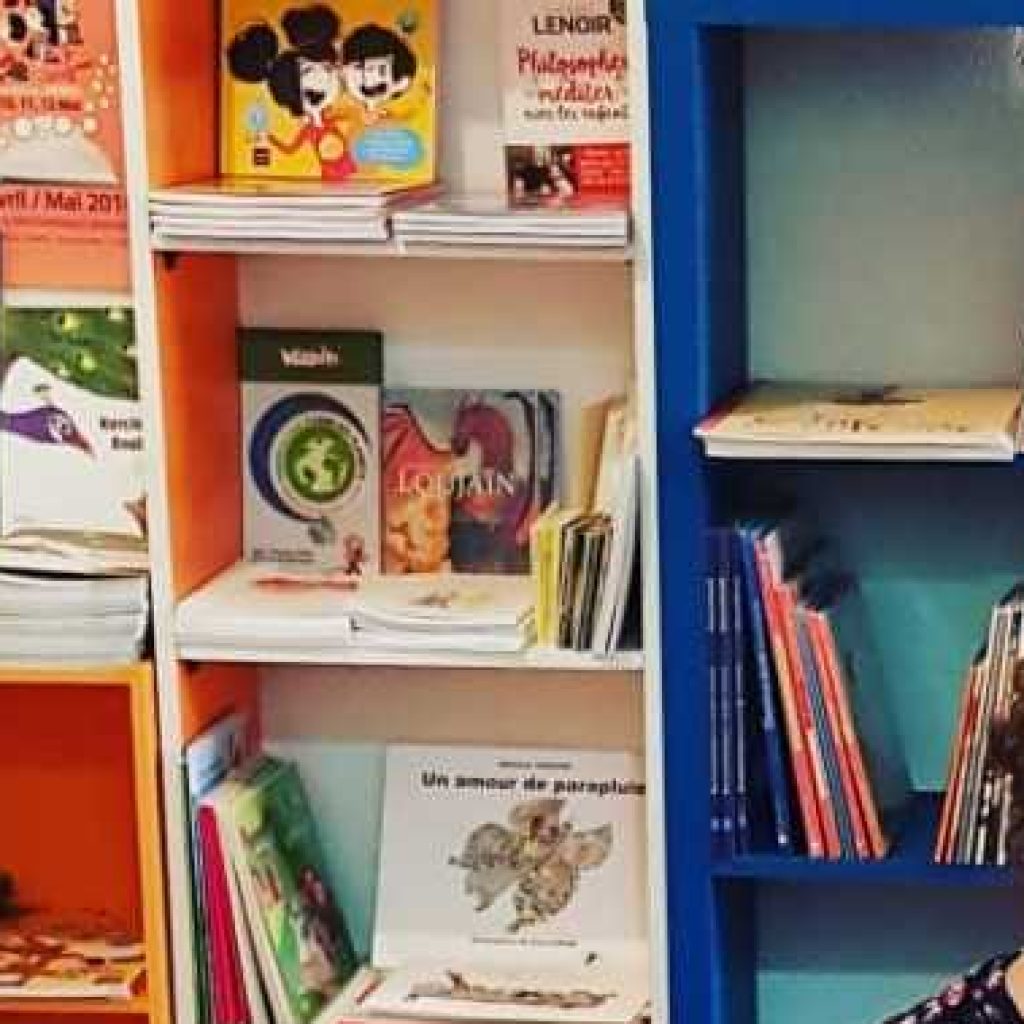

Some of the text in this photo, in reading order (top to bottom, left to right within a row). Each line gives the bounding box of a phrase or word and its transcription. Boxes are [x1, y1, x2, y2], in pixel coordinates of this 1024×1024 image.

[533, 15, 612, 35] LENOIR
[46, 191, 82, 211] Mai
[421, 770, 450, 788] Un
[455, 776, 516, 790] amour
[523, 775, 547, 790] de
